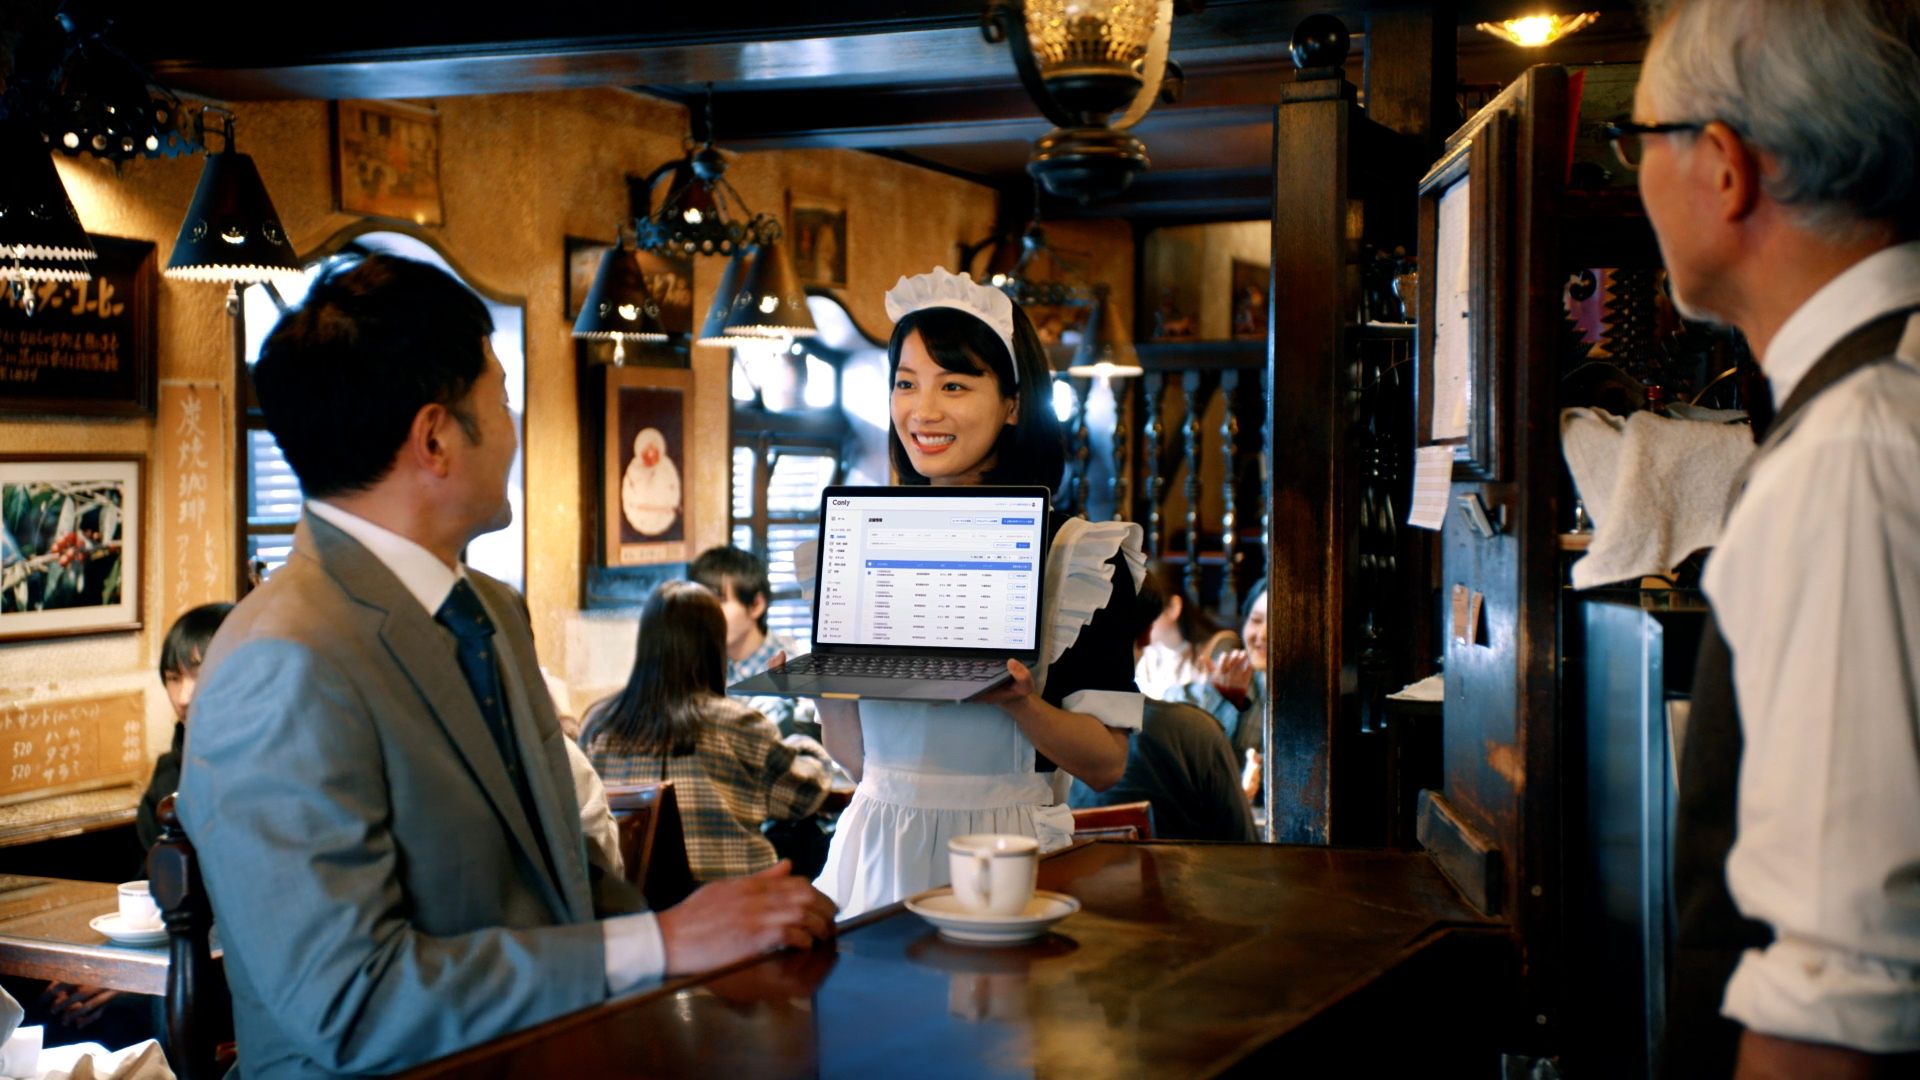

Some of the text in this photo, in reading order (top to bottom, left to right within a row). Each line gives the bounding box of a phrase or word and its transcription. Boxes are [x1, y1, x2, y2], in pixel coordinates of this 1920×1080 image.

[832, 499, 850, 507] Canly
[13, 741, 33, 759] 520
[10, 763, 32, 783] 520
